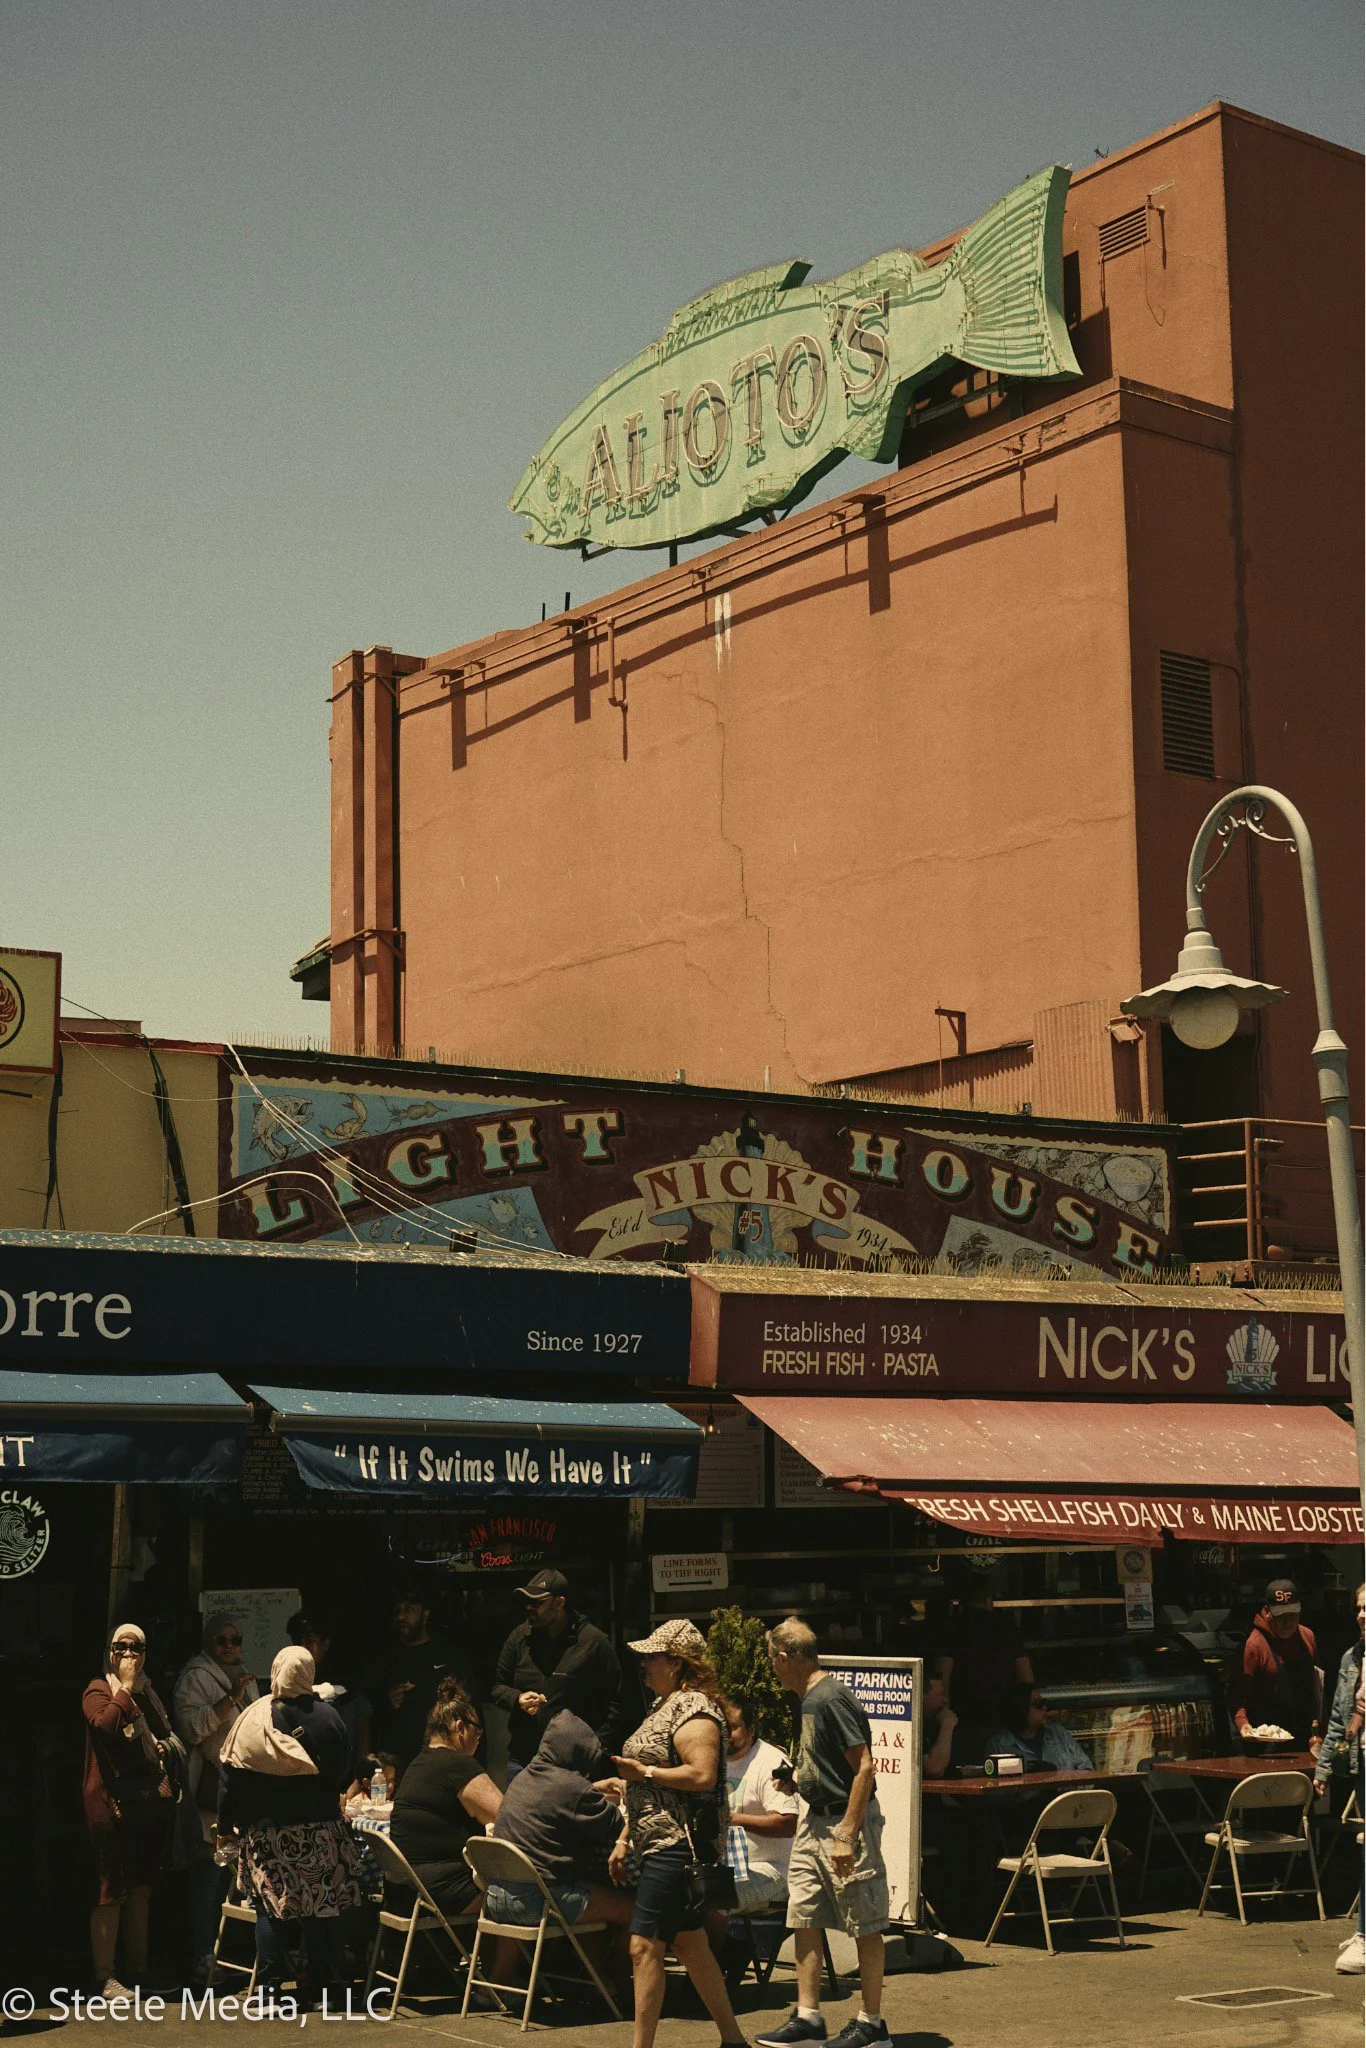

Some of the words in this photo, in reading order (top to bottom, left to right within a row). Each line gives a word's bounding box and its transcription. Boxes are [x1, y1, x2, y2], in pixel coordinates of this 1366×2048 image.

[577, 290, 890, 518] ALIOTO'S
[242, 1108, 626, 1238] LIGHT
[846, 1130, 1163, 1276] HOUSE
[644, 1160, 848, 1220] NICK'S
[608, 1210, 644, 1239] Est'd
[857, 1227, 889, 1252] 1934
[739, 1209, 763, 1243] #5
[527, 1331, 584, 1352] Since
[593, 1333, 643, 1354] 1927
[764, 1320, 866, 1344] Established
[880, 1324, 922, 1345] 1934
[1038, 1316, 1196, 1381] NICK'S
[1306, 1324, 1350, 1383] LI
[762, 1350, 820, 1375] FRESH
[826, 1351, 865, 1376] FISH
[883, 1352, 940, 1377] PASTA
[389, 1445, 408, 1481] It
[418, 1446, 495, 1483] Swims
[505, 1447, 540, 1484] We
[550, 1447, 604, 1485] Have
[1, 1490, 46, 1518] CLAW
[989, 1499, 1119, 1526] SHELLFISH
[1118, 1502, 1185, 1529] DAILY
[1192, 1506, 1206, 1525] &
[1211, 1504, 1286, 1532] MAINE
[14, 1529, 46, 1572] SELTZER
[480, 1551, 513, 1568] Coors
[663, 1559, 685, 1568] LINE
[687, 1557, 718, 1567] FORMS
[659, 1570, 672, 1579] TO
[675, 1569, 693, 1578] THE
[694, 1568, 722, 1577] RIGHT
[1275, 1590, 1292, 1602] SF
[854, 1672, 913, 1690] PARKING
[856, 1689, 884, 1702] DINING
[885, 1690, 911, 1703] ROOM
[877, 1704, 905, 1715] STAND
[894, 1732, 905, 1749] &
